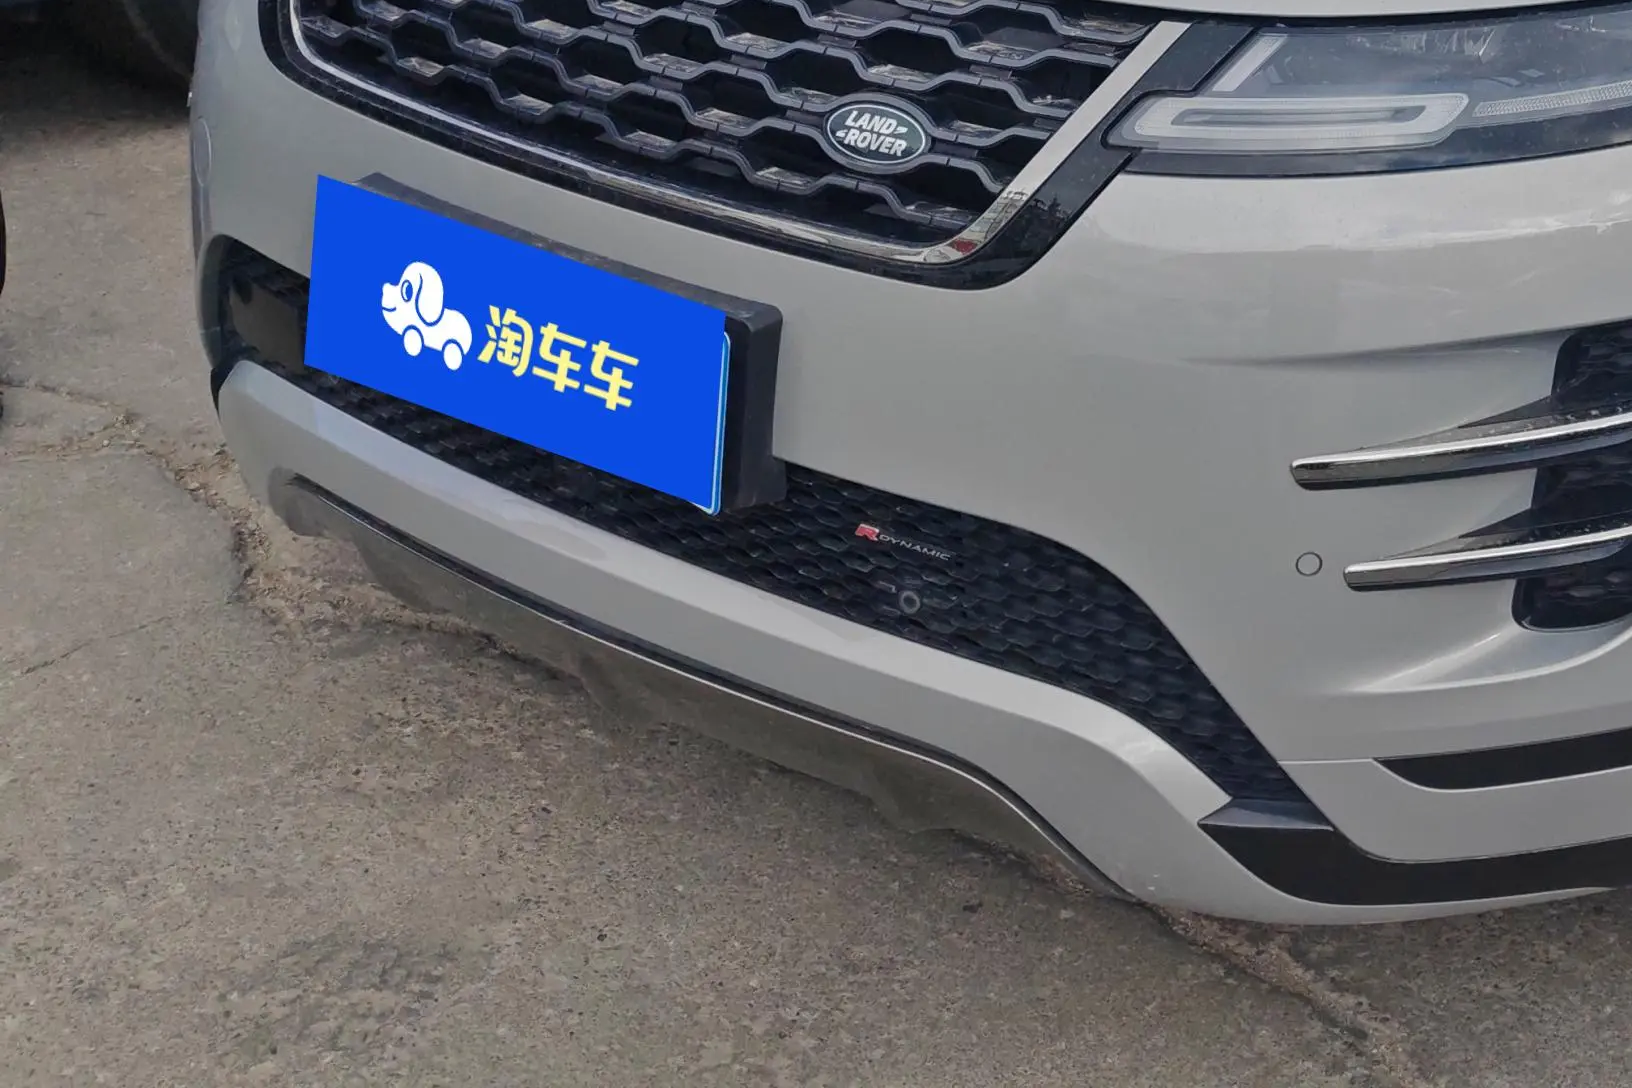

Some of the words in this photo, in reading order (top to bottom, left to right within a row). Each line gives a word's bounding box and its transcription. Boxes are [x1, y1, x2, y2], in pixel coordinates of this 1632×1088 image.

[844, 110, 898, 135] LAND
[843, 128, 908, 157] ROVER
[879, 534, 951, 561] DYNAMIC
